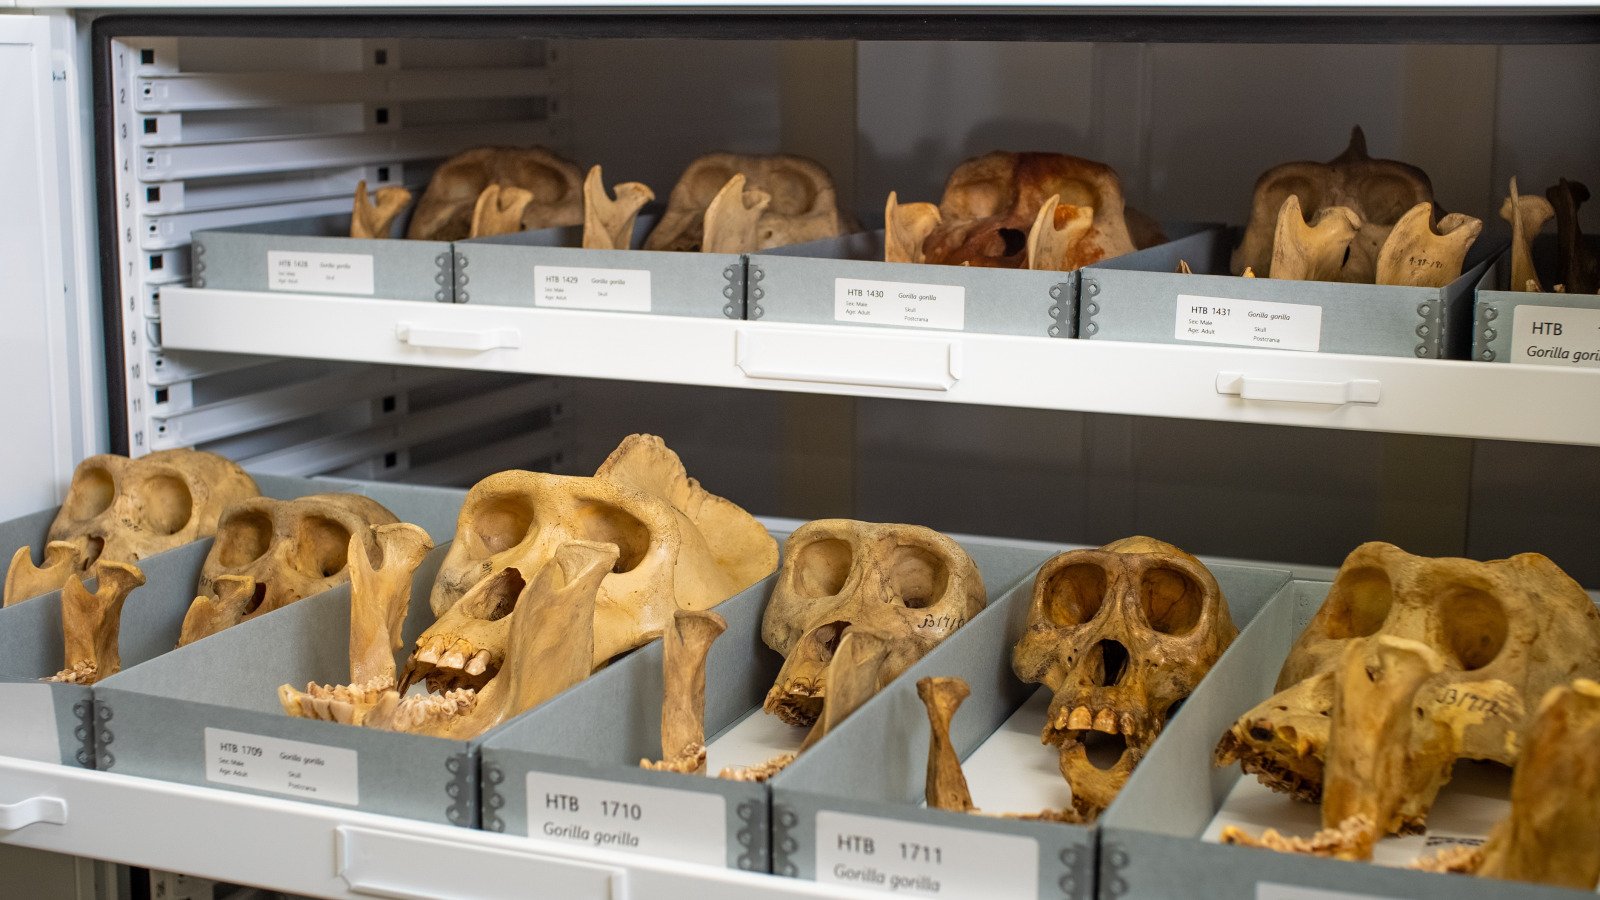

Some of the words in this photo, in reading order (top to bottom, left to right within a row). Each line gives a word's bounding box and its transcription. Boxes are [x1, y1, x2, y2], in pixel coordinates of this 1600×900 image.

[1192, 306, 1208, 314] HTB
[1212, 308, 1230, 316] 1431
[1532, 322, 1562, 336] HTB
[1526, 346, 1570, 358] Gorilla
[1572, 350, 1600, 362] gori
[220, 742, 238, 753] HTB
[242, 745, 262, 757] 1709
[280, 752, 301, 762] Gorilla
[303, 756, 324, 766] gorilla
[546, 793, 579, 812] HTB
[600, 800, 642, 820] 1710
[544, 822, 589, 840] Gorilla
[594, 830, 639, 847] gorilla
[837, 834, 875, 855] HTB
[900, 842, 942, 864] 1711
[834, 863, 886, 884] Gorilla
[890, 872, 940, 892] gorilla
